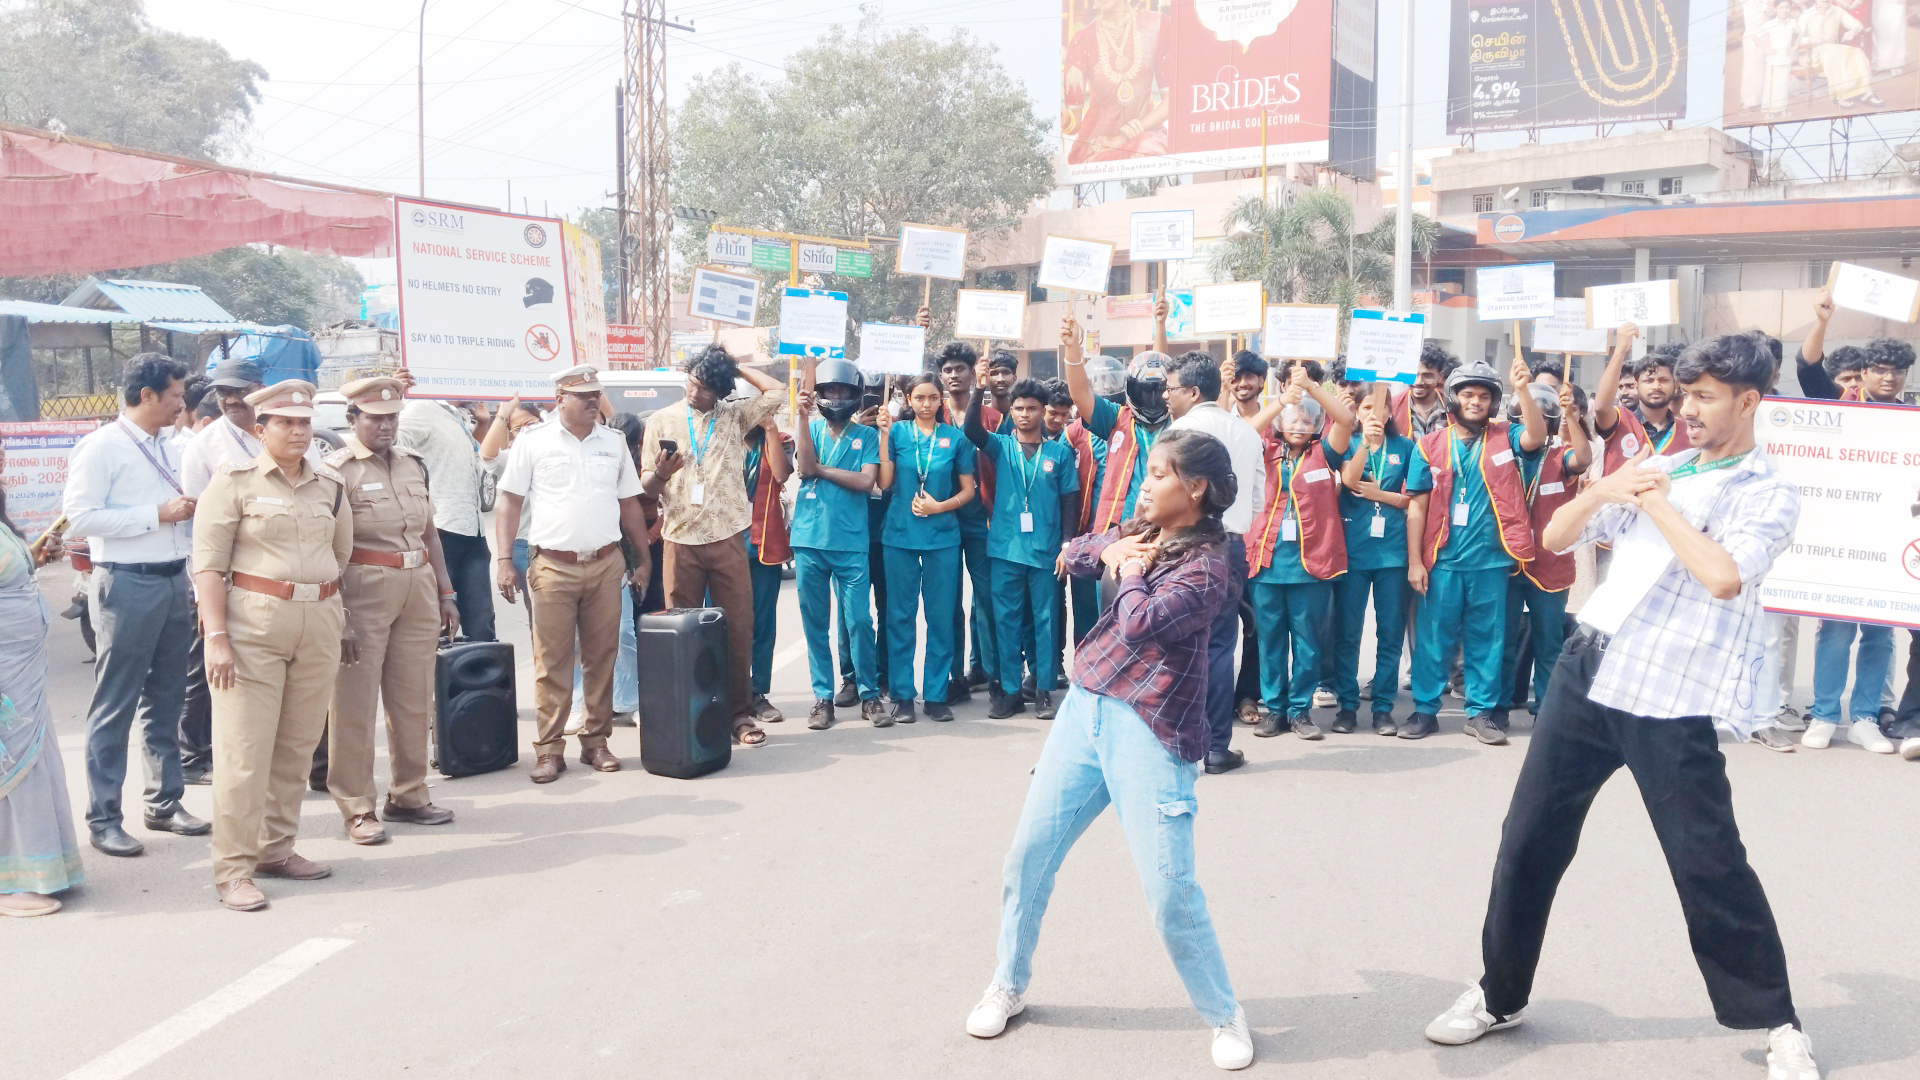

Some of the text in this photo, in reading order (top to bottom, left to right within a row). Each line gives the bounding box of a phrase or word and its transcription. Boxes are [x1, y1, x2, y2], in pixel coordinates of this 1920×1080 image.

[1218, 8, 1272, 22] JEWELLERS
[1471, 31, 1526, 48] செயின்
[1470, 47, 1526, 63] திருவிழா
[1191, 66, 1300, 113] BRIDES
[1473, 81, 1520, 99] 4.9%
[1190, 114, 1300, 133] THE BRIDAL COLECTION
[428, 211, 464, 230] SRM
[413, 242, 551, 267] NATIONAL SERVICE SCHEME
[803, 249, 833, 264] Shifa
[408, 278, 502, 296] NO HELMETS NO ENTRY
[411, 332, 515, 348] SAY NO TO TRIPLE RIDING
[608, 343, 645, 353] CIDENT ZONE
[415, 376, 430, 384] SRM
[431, 377, 466, 386] INSTITUTE
[468, 378, 477, 386] OF
[479, 379, 506, 387] SCIENCE
[525, 380, 556, 388] TECHNOL
[1792, 410, 1844, 427] SRM
[0, 436, 46, 447] சங்கல்பட்டு
[1766, 442, 1920, 466] NATIONAL SERVICE SC
[42, 457, 68, 470] பாது
[1703, 462, 1717, 471] SRM
[38, 471, 68, 484] 2026
[1795, 486, 1882, 502] METS NO ENTRY
[1790, 544, 1887, 562] TO TRIPLE RIDING
[1763, 587, 1920, 613] INSTITUTE OF SCIENCE AND TECHN
